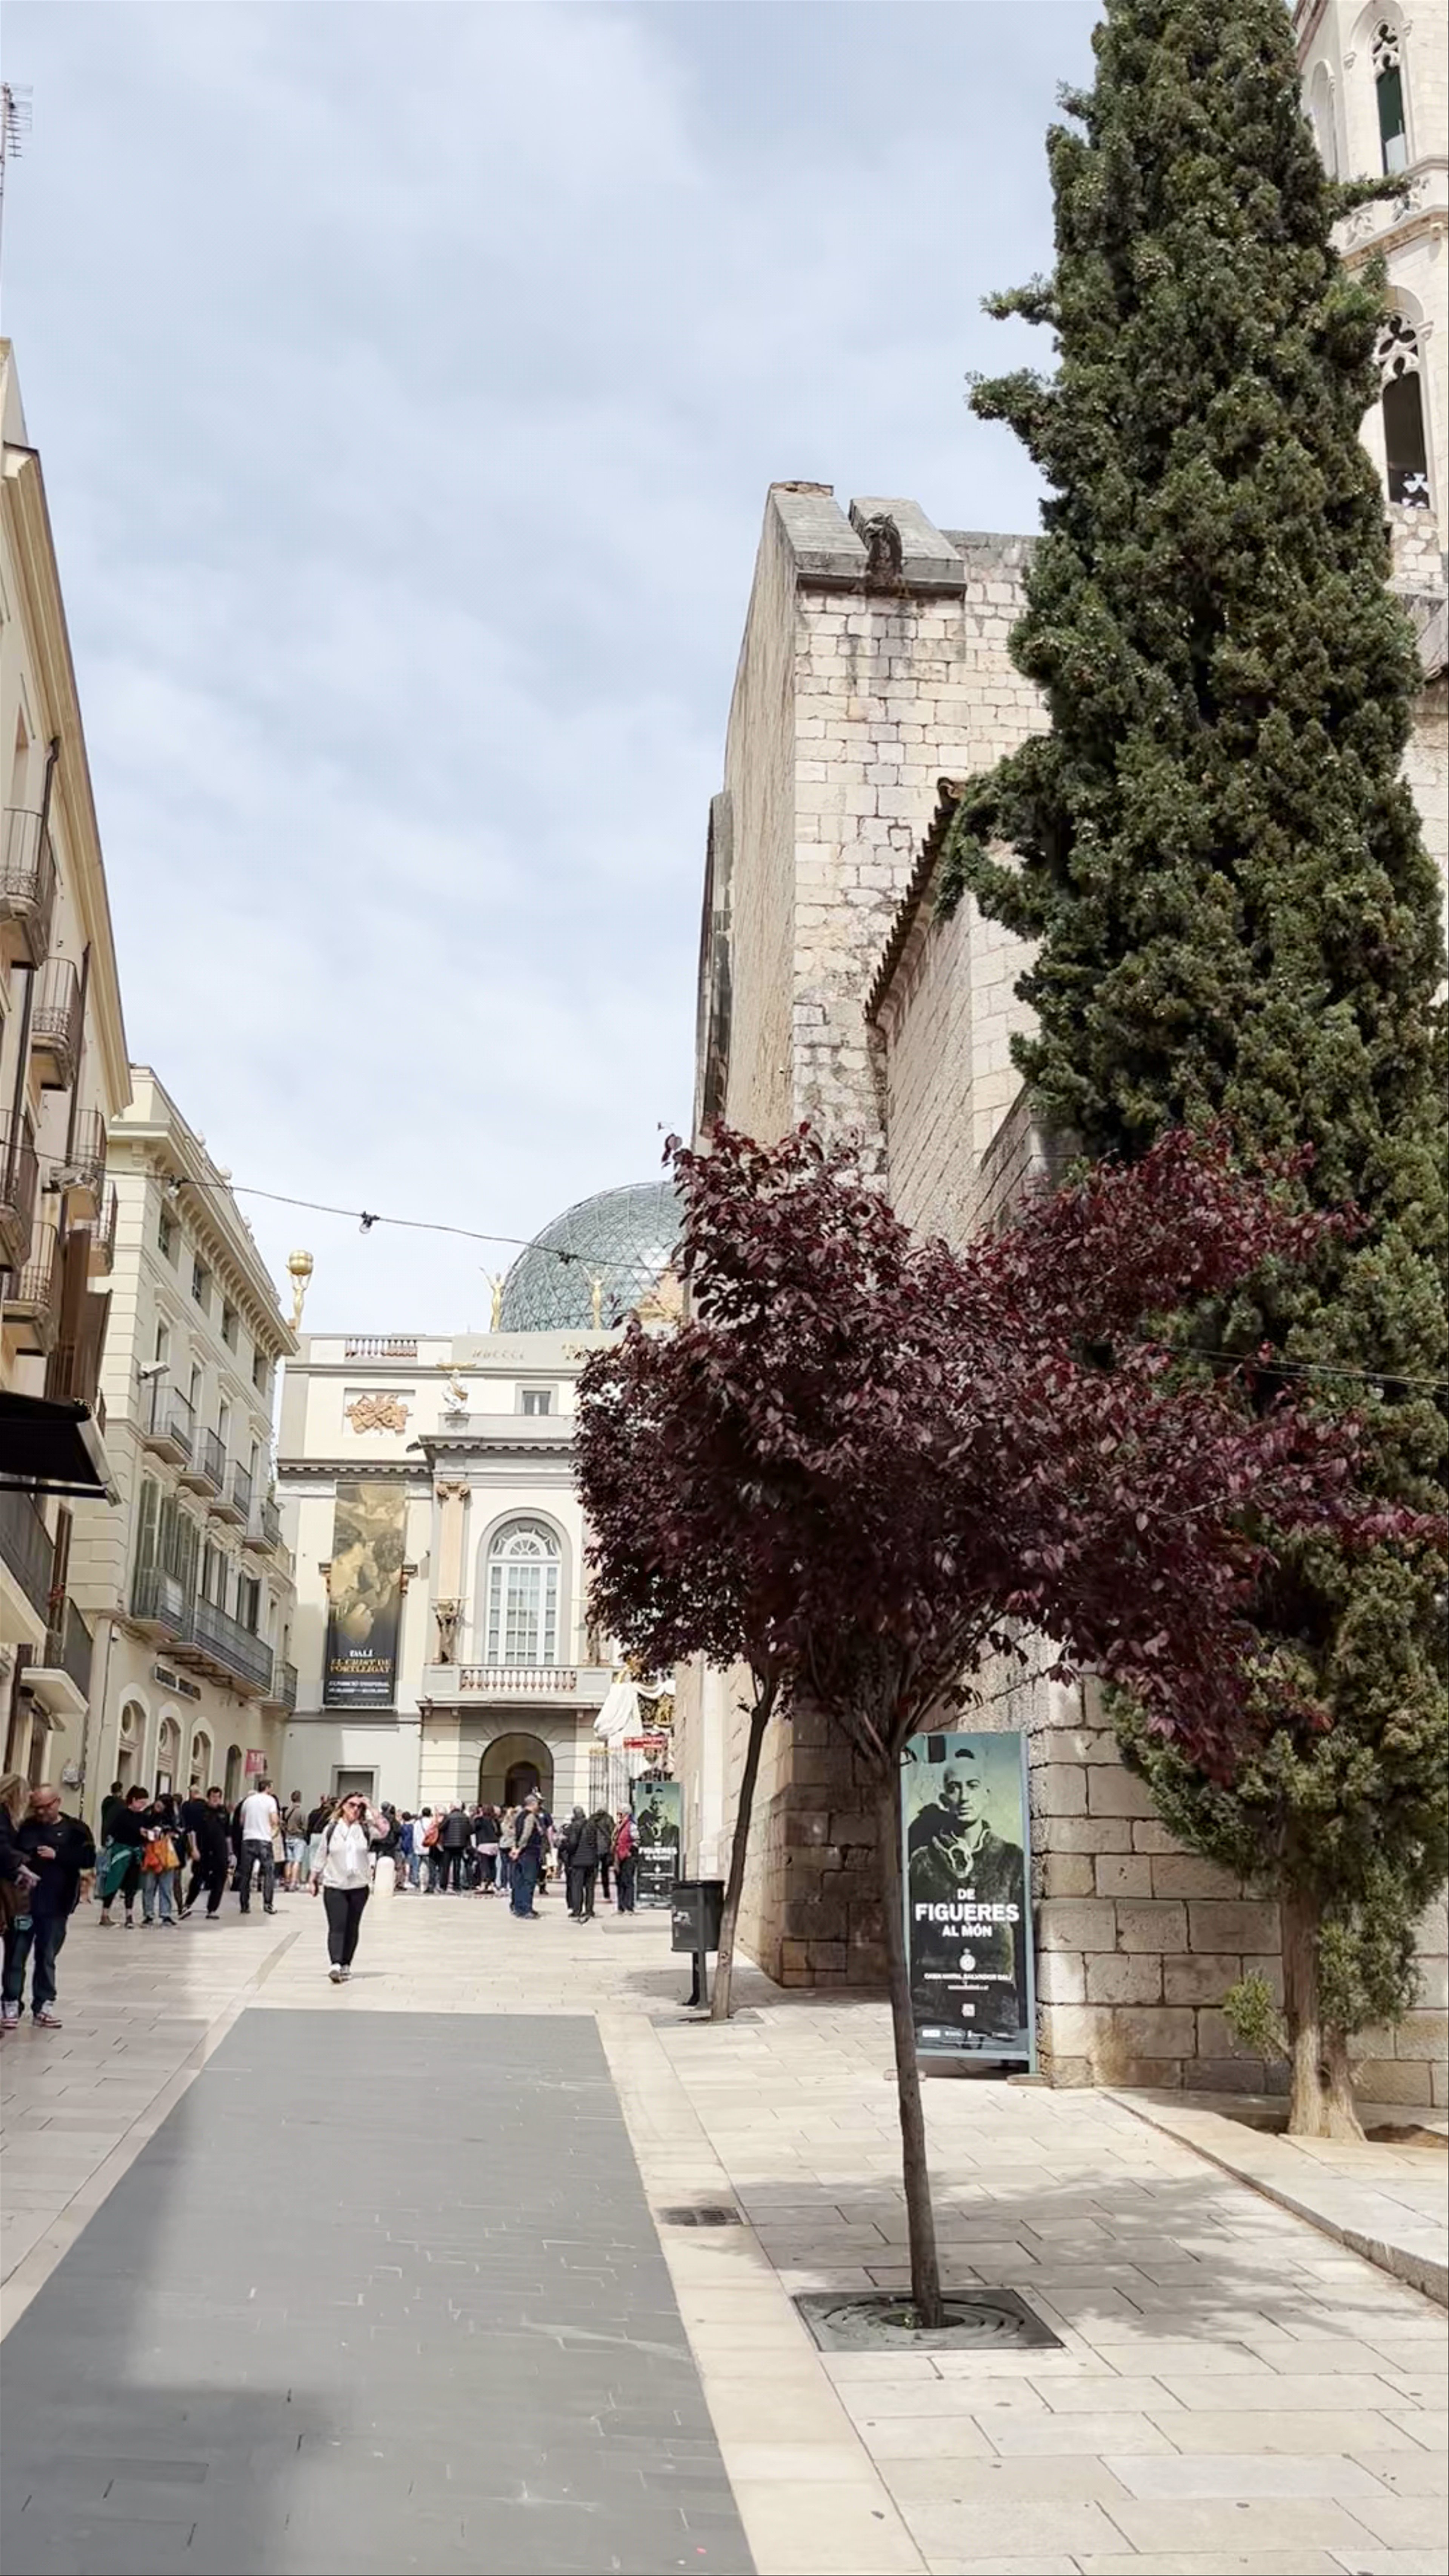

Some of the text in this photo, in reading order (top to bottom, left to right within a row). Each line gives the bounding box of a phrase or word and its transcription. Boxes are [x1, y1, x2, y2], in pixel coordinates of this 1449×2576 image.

[957, 1888, 975, 1900] DE
[915, 1903, 1020, 1921] FIGUERES
[942, 1923, 992, 1937] AL MÓN
